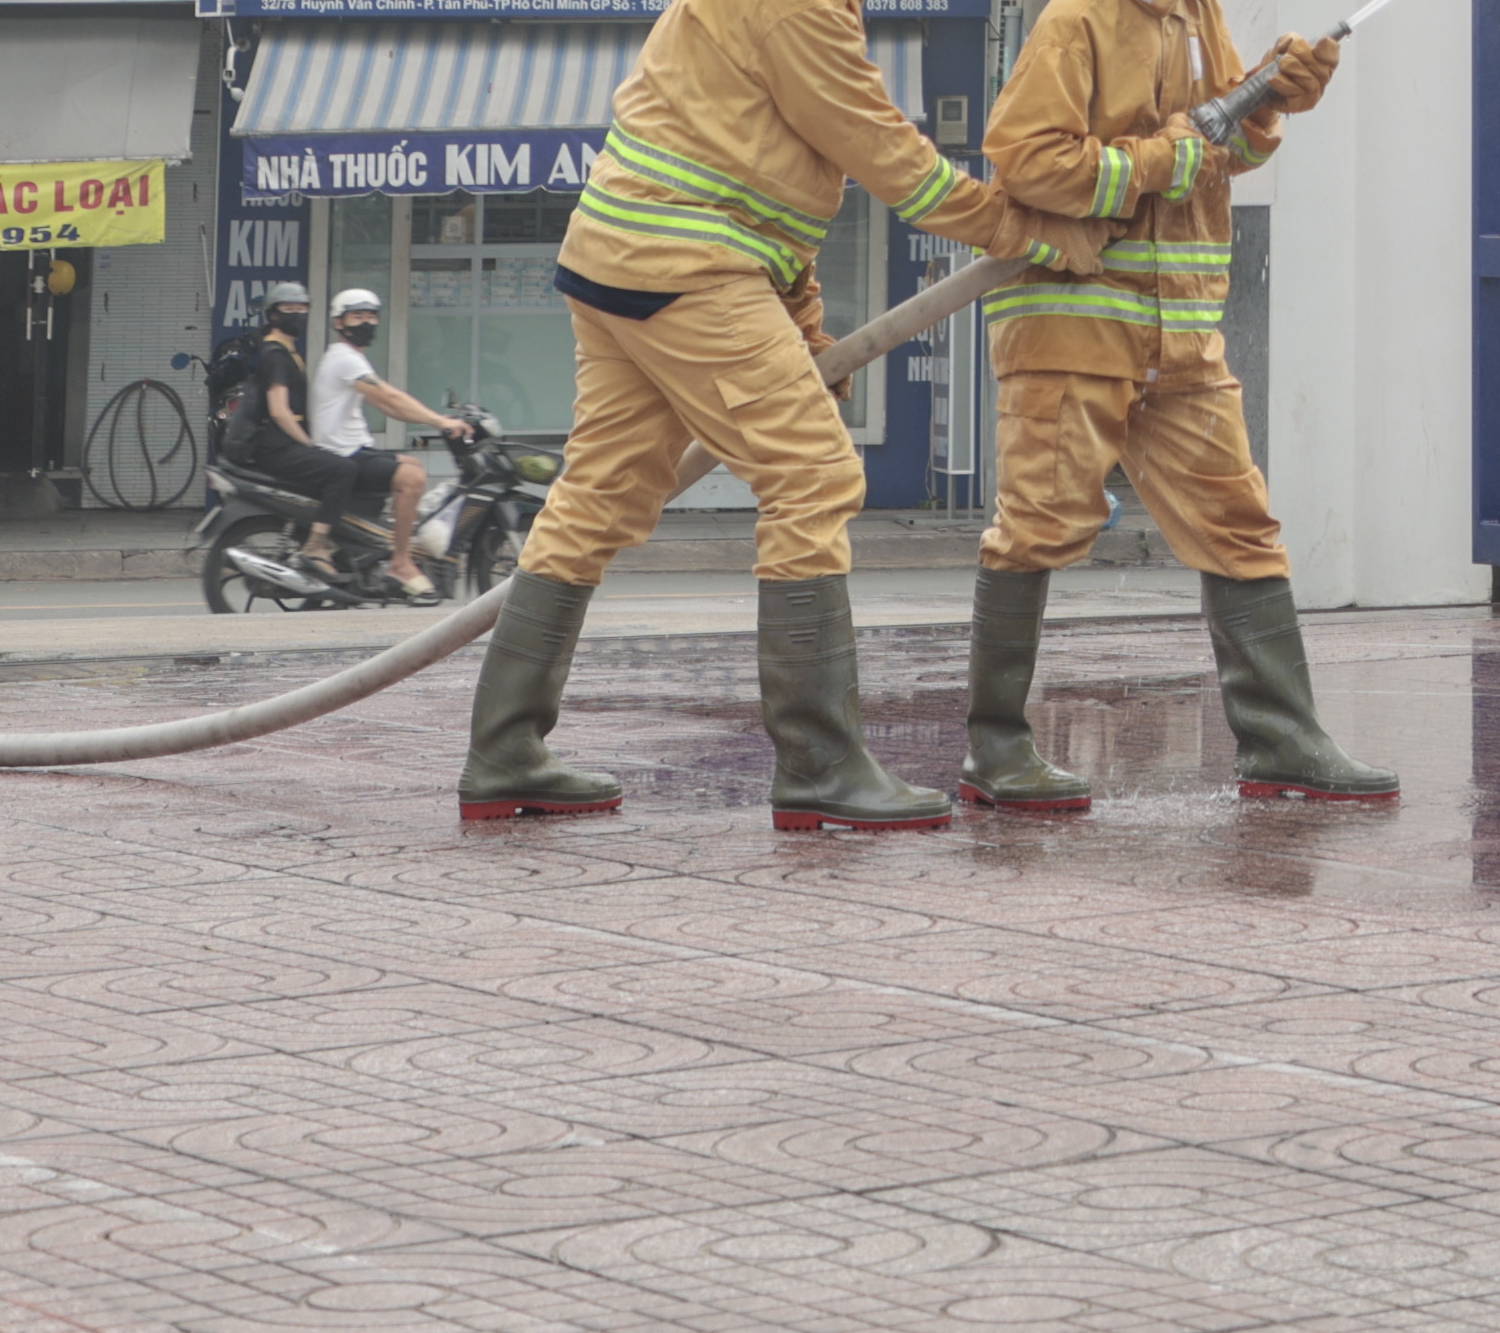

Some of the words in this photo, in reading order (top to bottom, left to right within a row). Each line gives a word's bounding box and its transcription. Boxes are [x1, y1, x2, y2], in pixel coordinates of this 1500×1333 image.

[257, 148, 321, 190] NHÀ
[329, 139, 428, 188] THUỐC
[445, 142, 531, 186] KIM
[548, 142, 601, 184] AN
[54, 174, 150, 215] LOẠI
[228, 220, 299, 268] KIM
